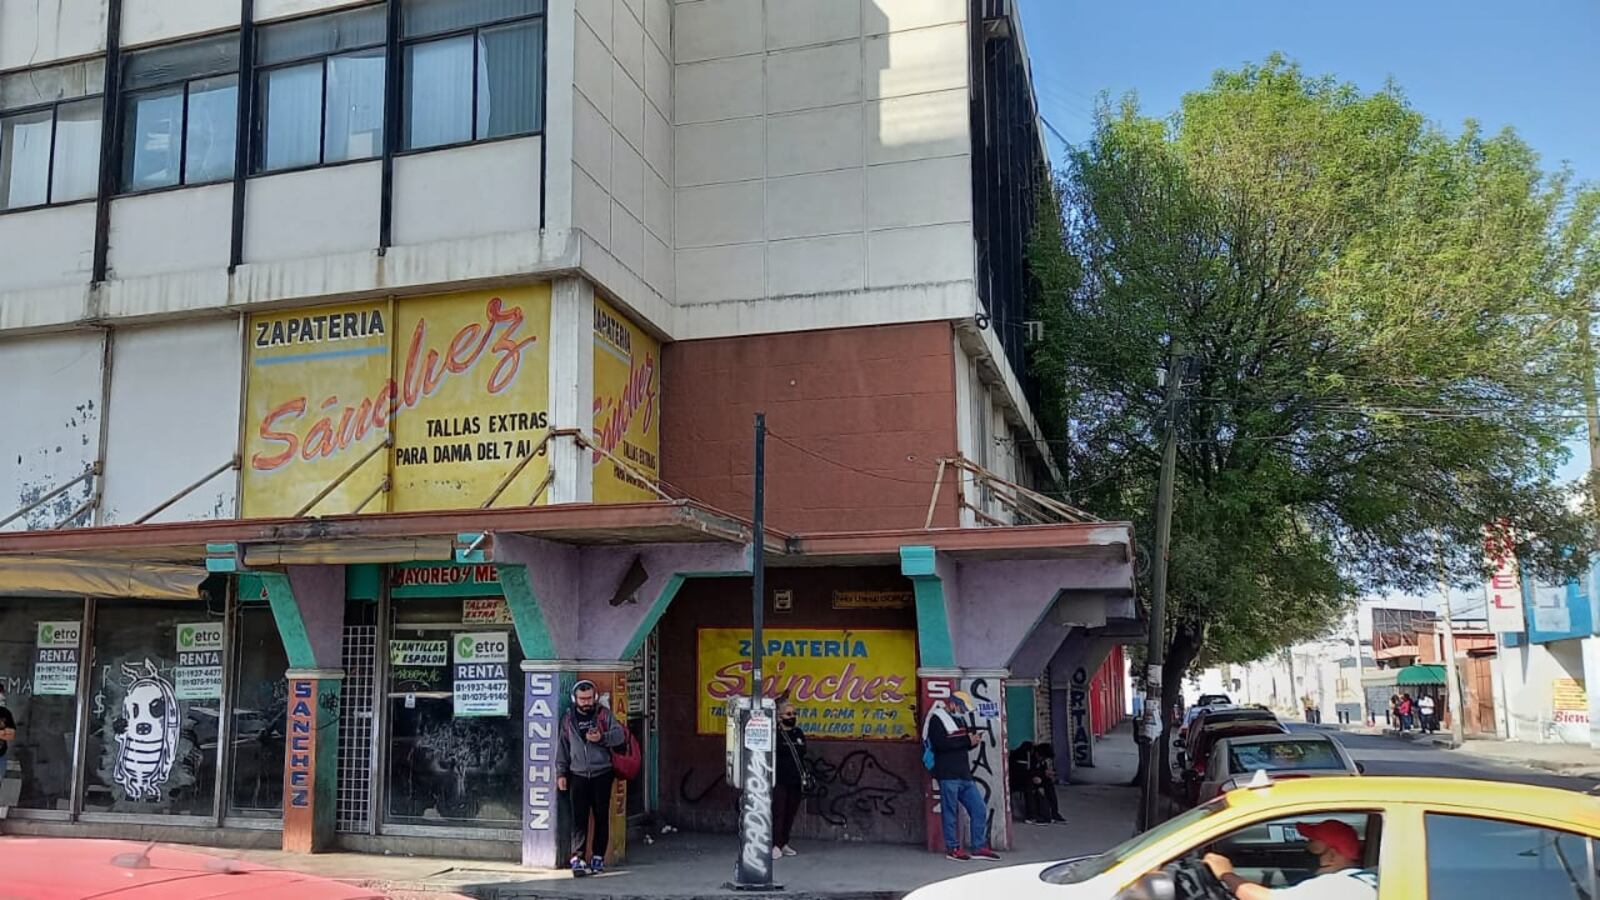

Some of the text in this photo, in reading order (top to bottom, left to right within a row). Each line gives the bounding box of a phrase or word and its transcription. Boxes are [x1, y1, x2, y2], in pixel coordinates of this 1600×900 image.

[256, 310, 385, 348] ZAPATERIA
[594, 305, 632, 353] APATERIA
[252, 297, 537, 471] Sánchez
[426, 411, 548, 437] TALLAS EXTRAS
[396, 445, 428, 466] PARA
[434, 442, 472, 464] DAMA
[477, 442, 500, 461] DEL
[504, 441, 513, 459] 7
[394, 566, 460, 584] MAYOREO
[474, 565, 500, 583] ME
[40, 649, 76, 662] RENTA
[179, 652, 220, 666] RENTA
[390, 641, 446, 653] PLANTILLAS
[402, 654, 446, 664] ESPOLON
[458, 636, 506, 658] Metro
[458, 665, 505, 678] RENTA
[706, 660, 908, 703] Sánchez
[290, 681, 312, 808] SANCHEZ
[527, 673, 553, 830] SANCHEZ
